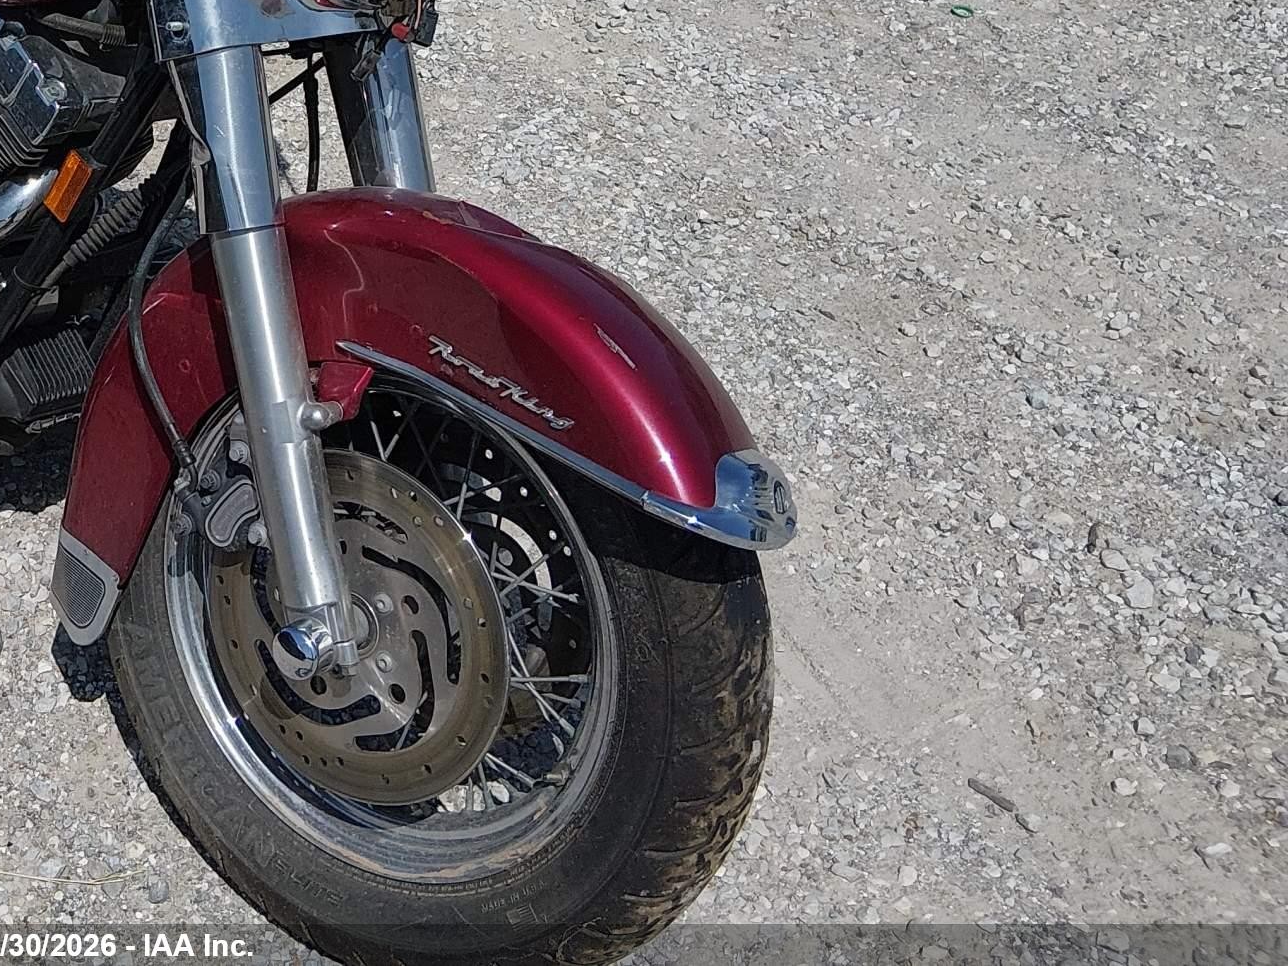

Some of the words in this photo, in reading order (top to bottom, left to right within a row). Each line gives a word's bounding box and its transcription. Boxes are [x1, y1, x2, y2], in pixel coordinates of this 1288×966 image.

[428, 334, 500, 389] Road
[497, 376, 575, 430] King
[272, 856, 345, 908] ELITE
